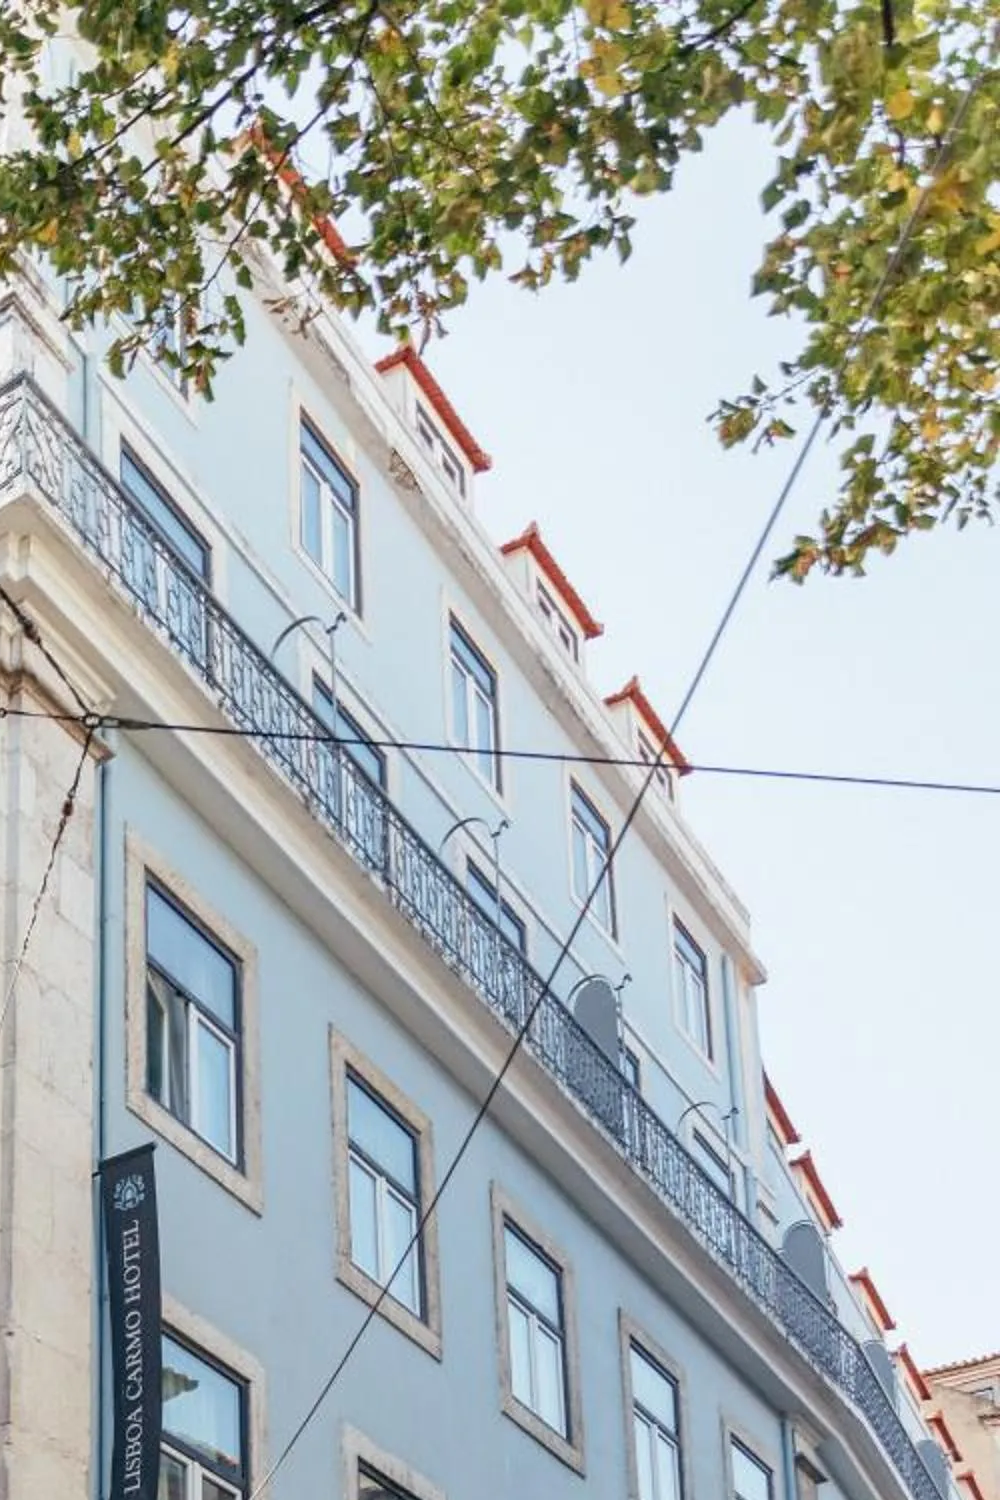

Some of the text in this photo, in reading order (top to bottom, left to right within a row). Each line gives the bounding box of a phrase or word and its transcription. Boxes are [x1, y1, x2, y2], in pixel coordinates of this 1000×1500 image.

[123, 1219, 143, 1493] LISBOA CARMO HOTEL
